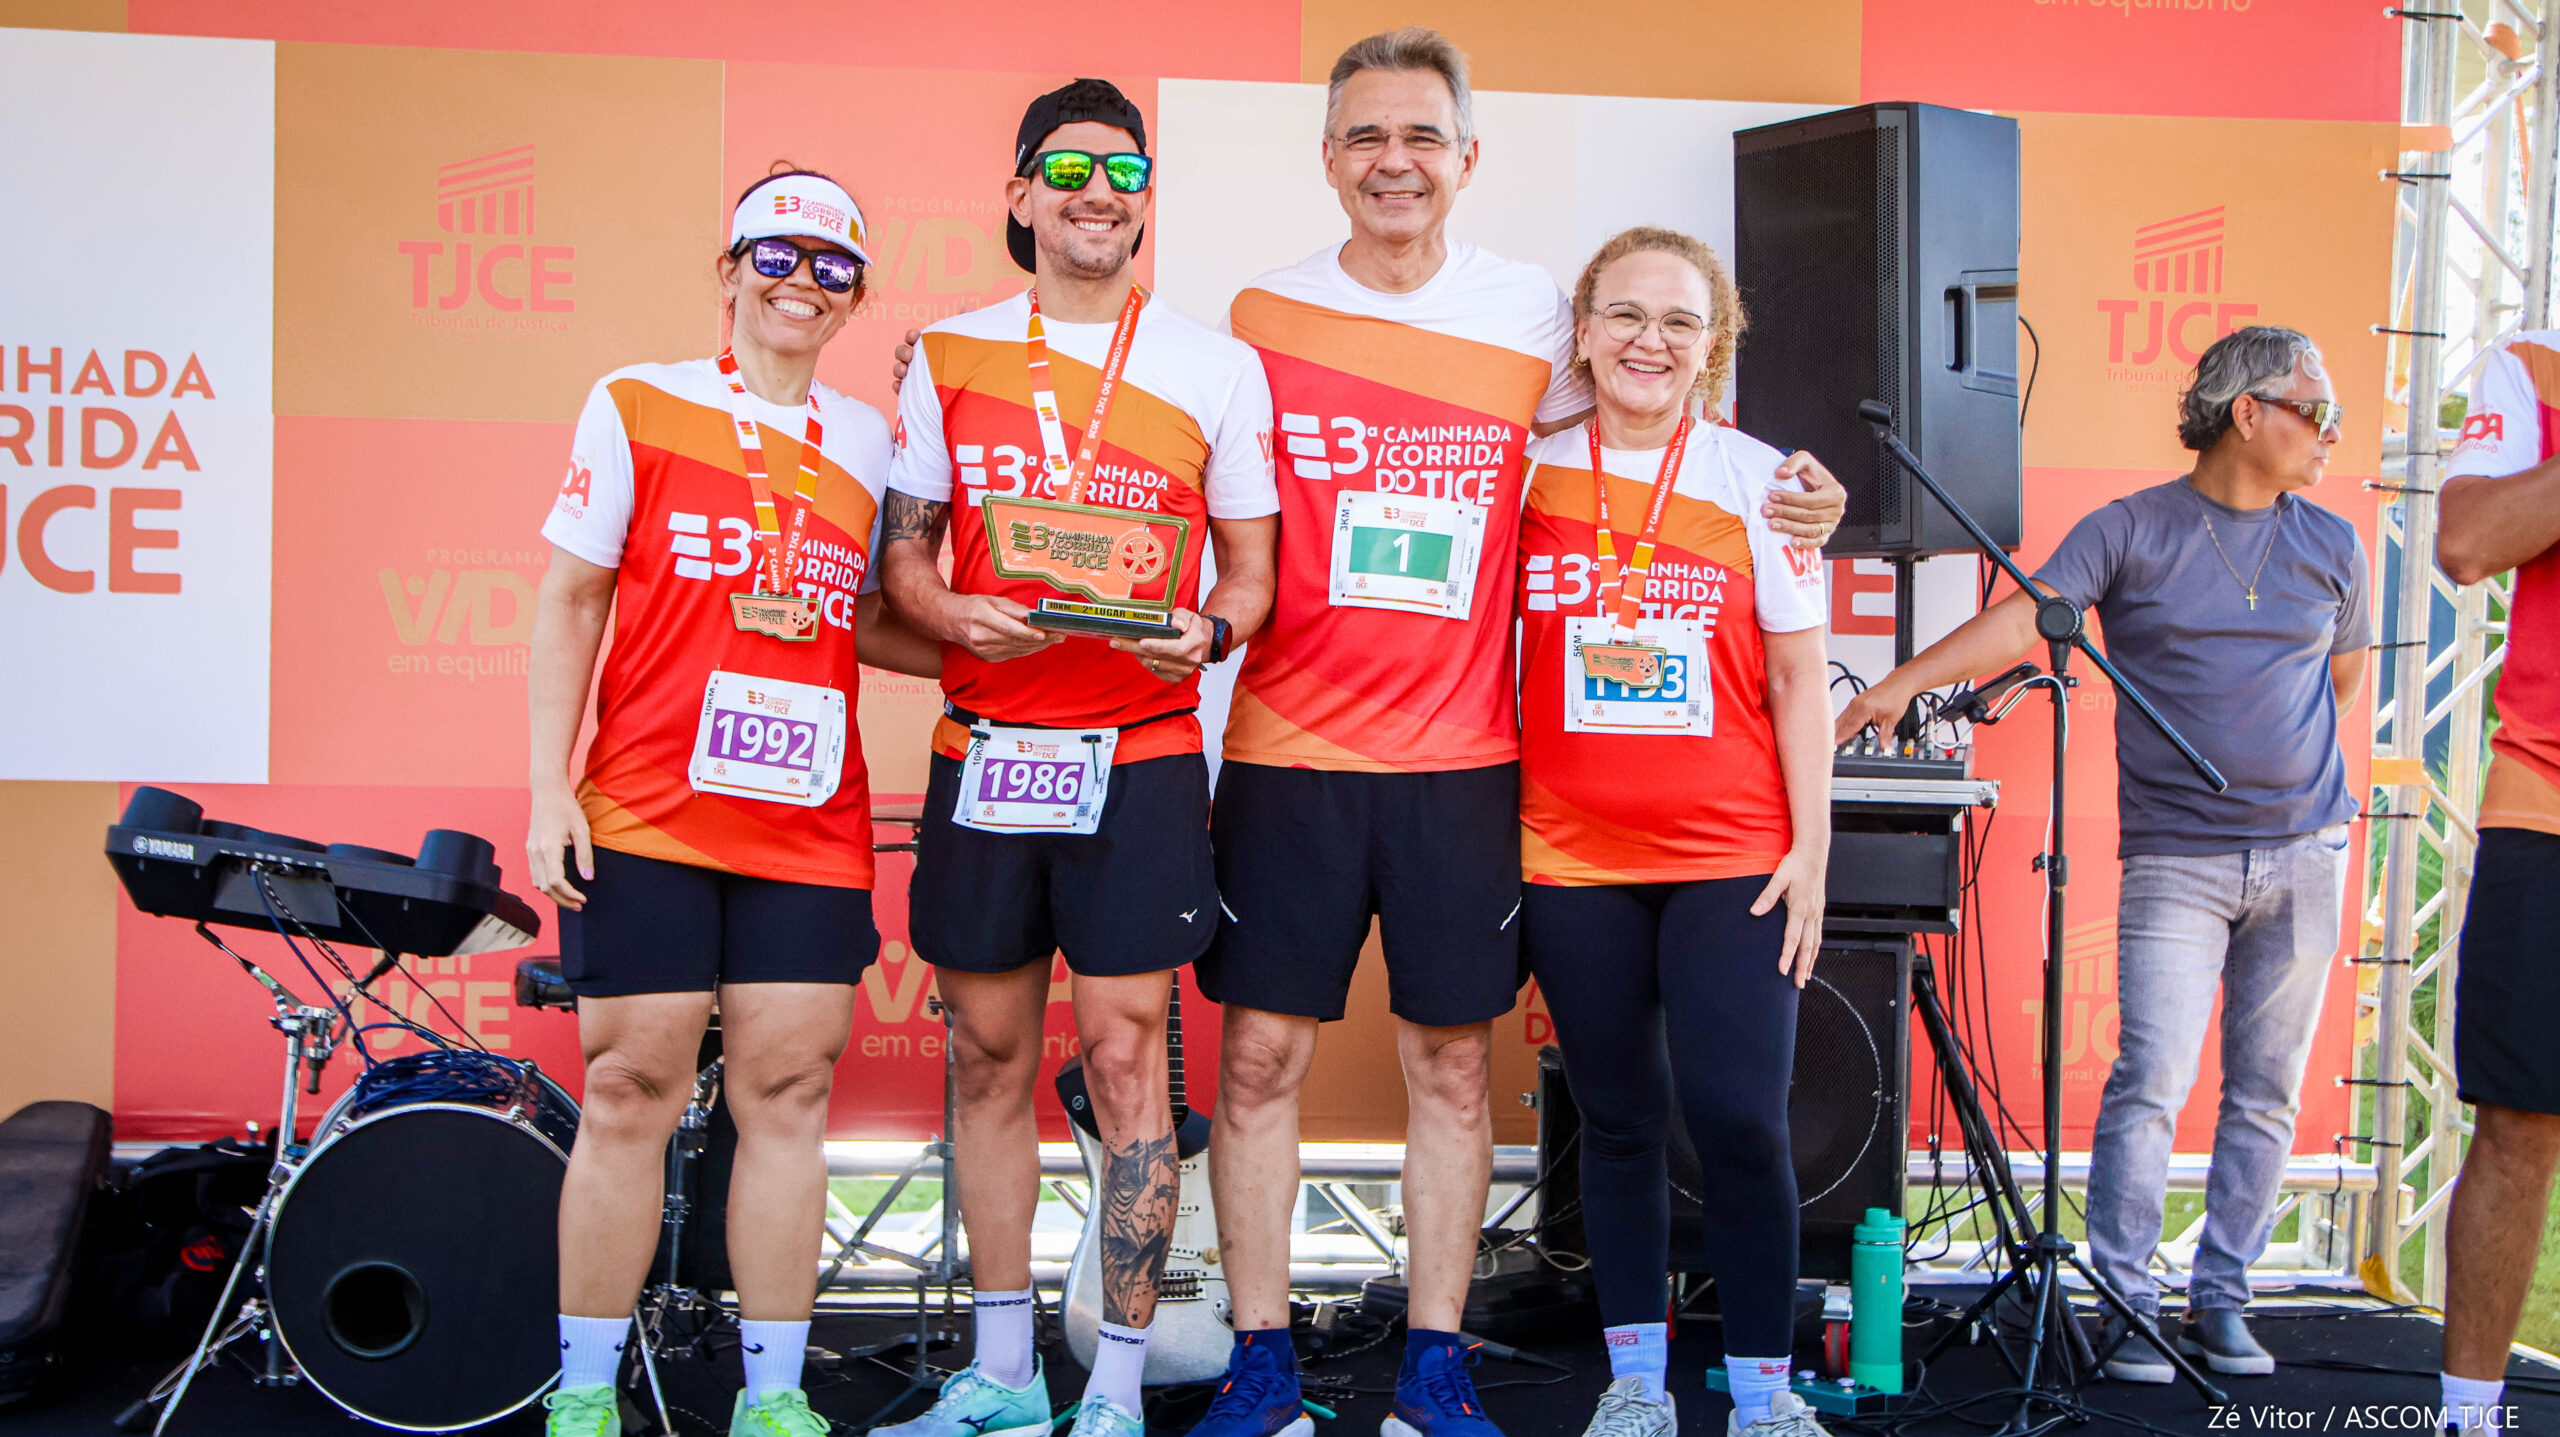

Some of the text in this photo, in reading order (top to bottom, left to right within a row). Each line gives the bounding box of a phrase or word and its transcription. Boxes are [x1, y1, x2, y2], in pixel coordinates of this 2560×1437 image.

[884, 196, 1000, 216] PROGRAMA
[801, 211, 843, 234] DO TJCE
[398, 240, 576, 313] TJCE
[411, 312, 480, 329] Tribunal
[486, 315, 508, 330] de
[0, 345, 216, 400] HADA
[2107, 367, 2169, 383] Tribunal
[1101, 381, 1114, 396] DO
[1088, 419, 1101, 440] 2026
[1383, 425, 1512, 443] CAMINHADA
[1374, 444, 1504, 467] /CORRIDA
[1375, 468, 1499, 505] DO TJCE
[1339, 508, 1350, 532] 3KM
[0, 483, 182, 595] CE
[1049, 538, 1112, 555] /CORRIDA
[1054, 529, 1114, 545] CAMINHADA
[426, 549, 546, 566] PROGRAMA
[1049, 547, 1109, 571] DO TJCE
[1393, 532, 1411, 573] 1
[379, 567, 542, 646] VID
[1049, 601, 1071, 611] 10KM
[1094, 606, 1126, 618] LUGAR
[1573, 634, 1582, 657] 5KM
[387, 653, 430, 674] em
[704, 687, 715, 717] 10KM
[715, 713, 814, 768] 1992
[972, 740, 985, 767] 10KM
[985, 761, 1082, 802] 1986
[861, 1034, 911, 1058] em
